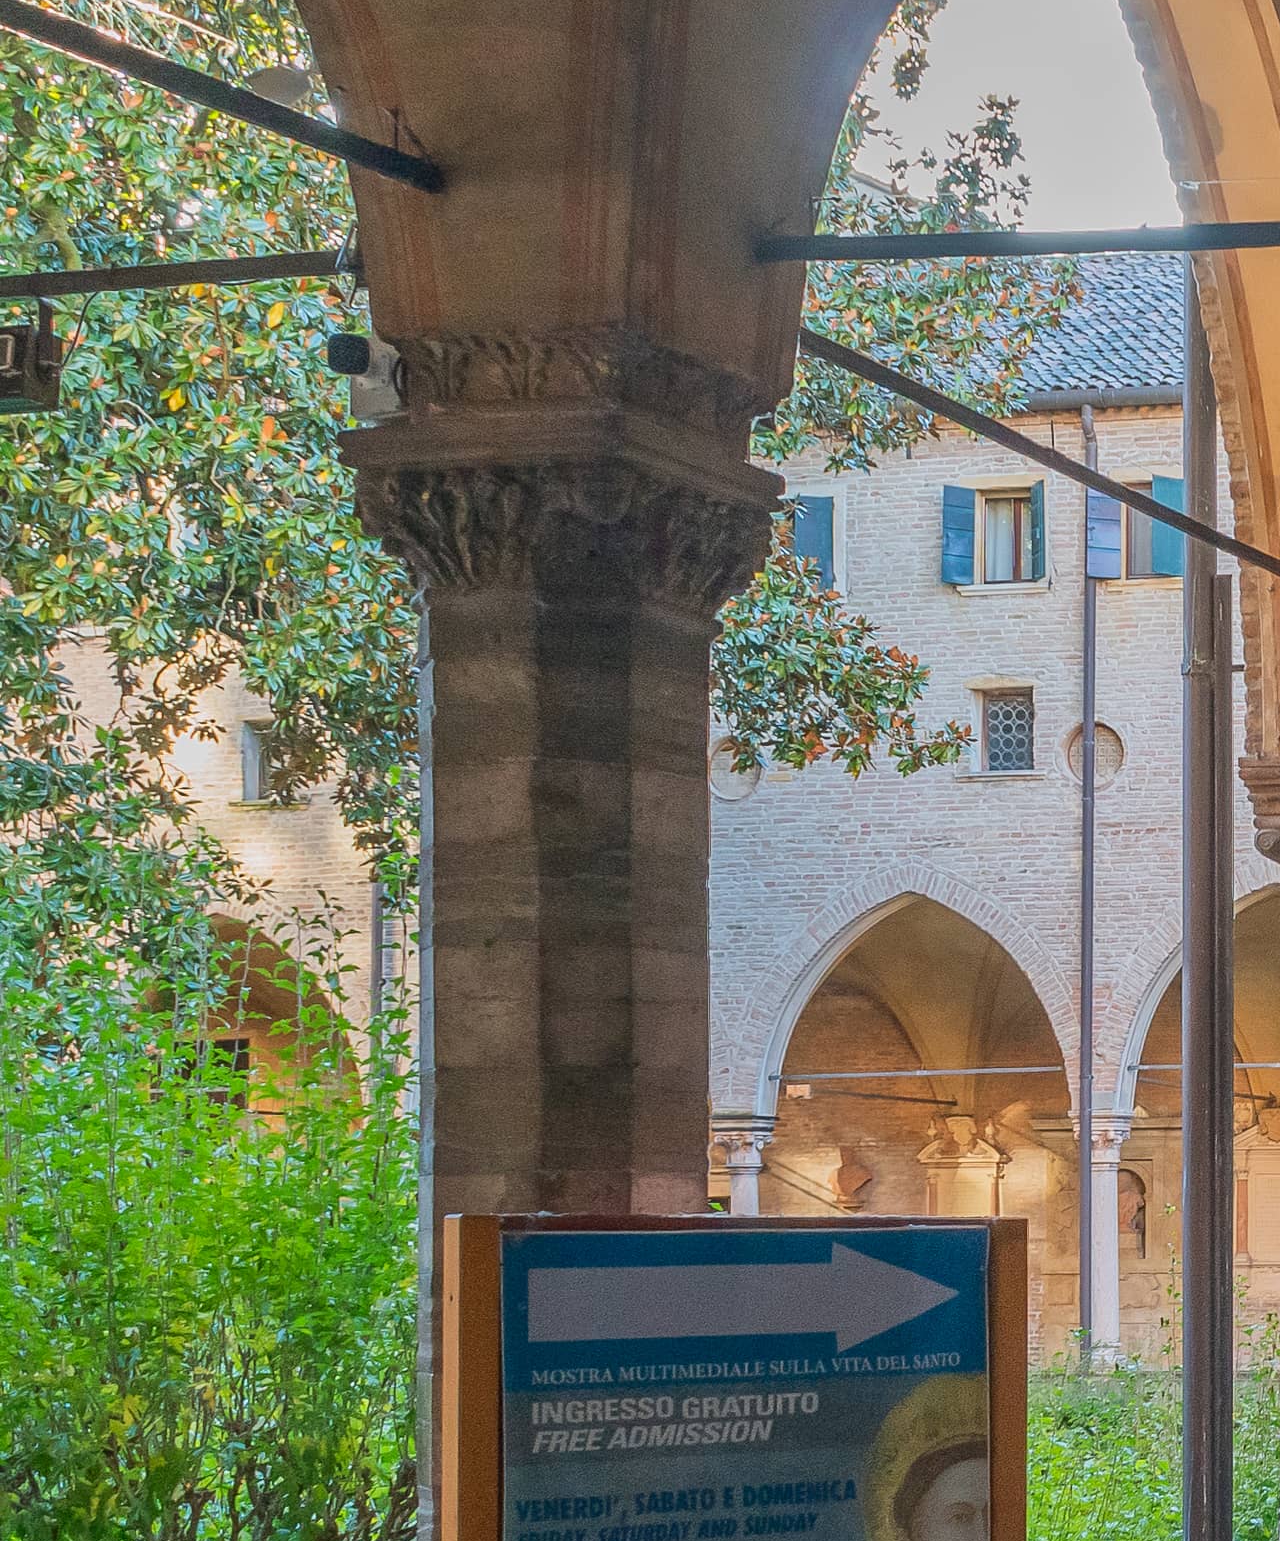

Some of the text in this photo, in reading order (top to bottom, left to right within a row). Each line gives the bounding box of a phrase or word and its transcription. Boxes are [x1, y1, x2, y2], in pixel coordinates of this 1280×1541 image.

[531, 1352, 961, 1386] MOSTRA MULTIMEDIALE SULLA VITA DEL SANTO
[531, 1391, 819, 1425] INGRESSO GRATUITO
[532, 1419, 774, 1453] FREE ADMISSION
[634, 1487, 716, 1515] SABATO
[724, 1486, 735, 1509] E
[742, 1479, 857, 1507] DOMENICA
[698, 1518, 738, 1539] AND
[743, 1513, 819, 1536] SUNDAY
